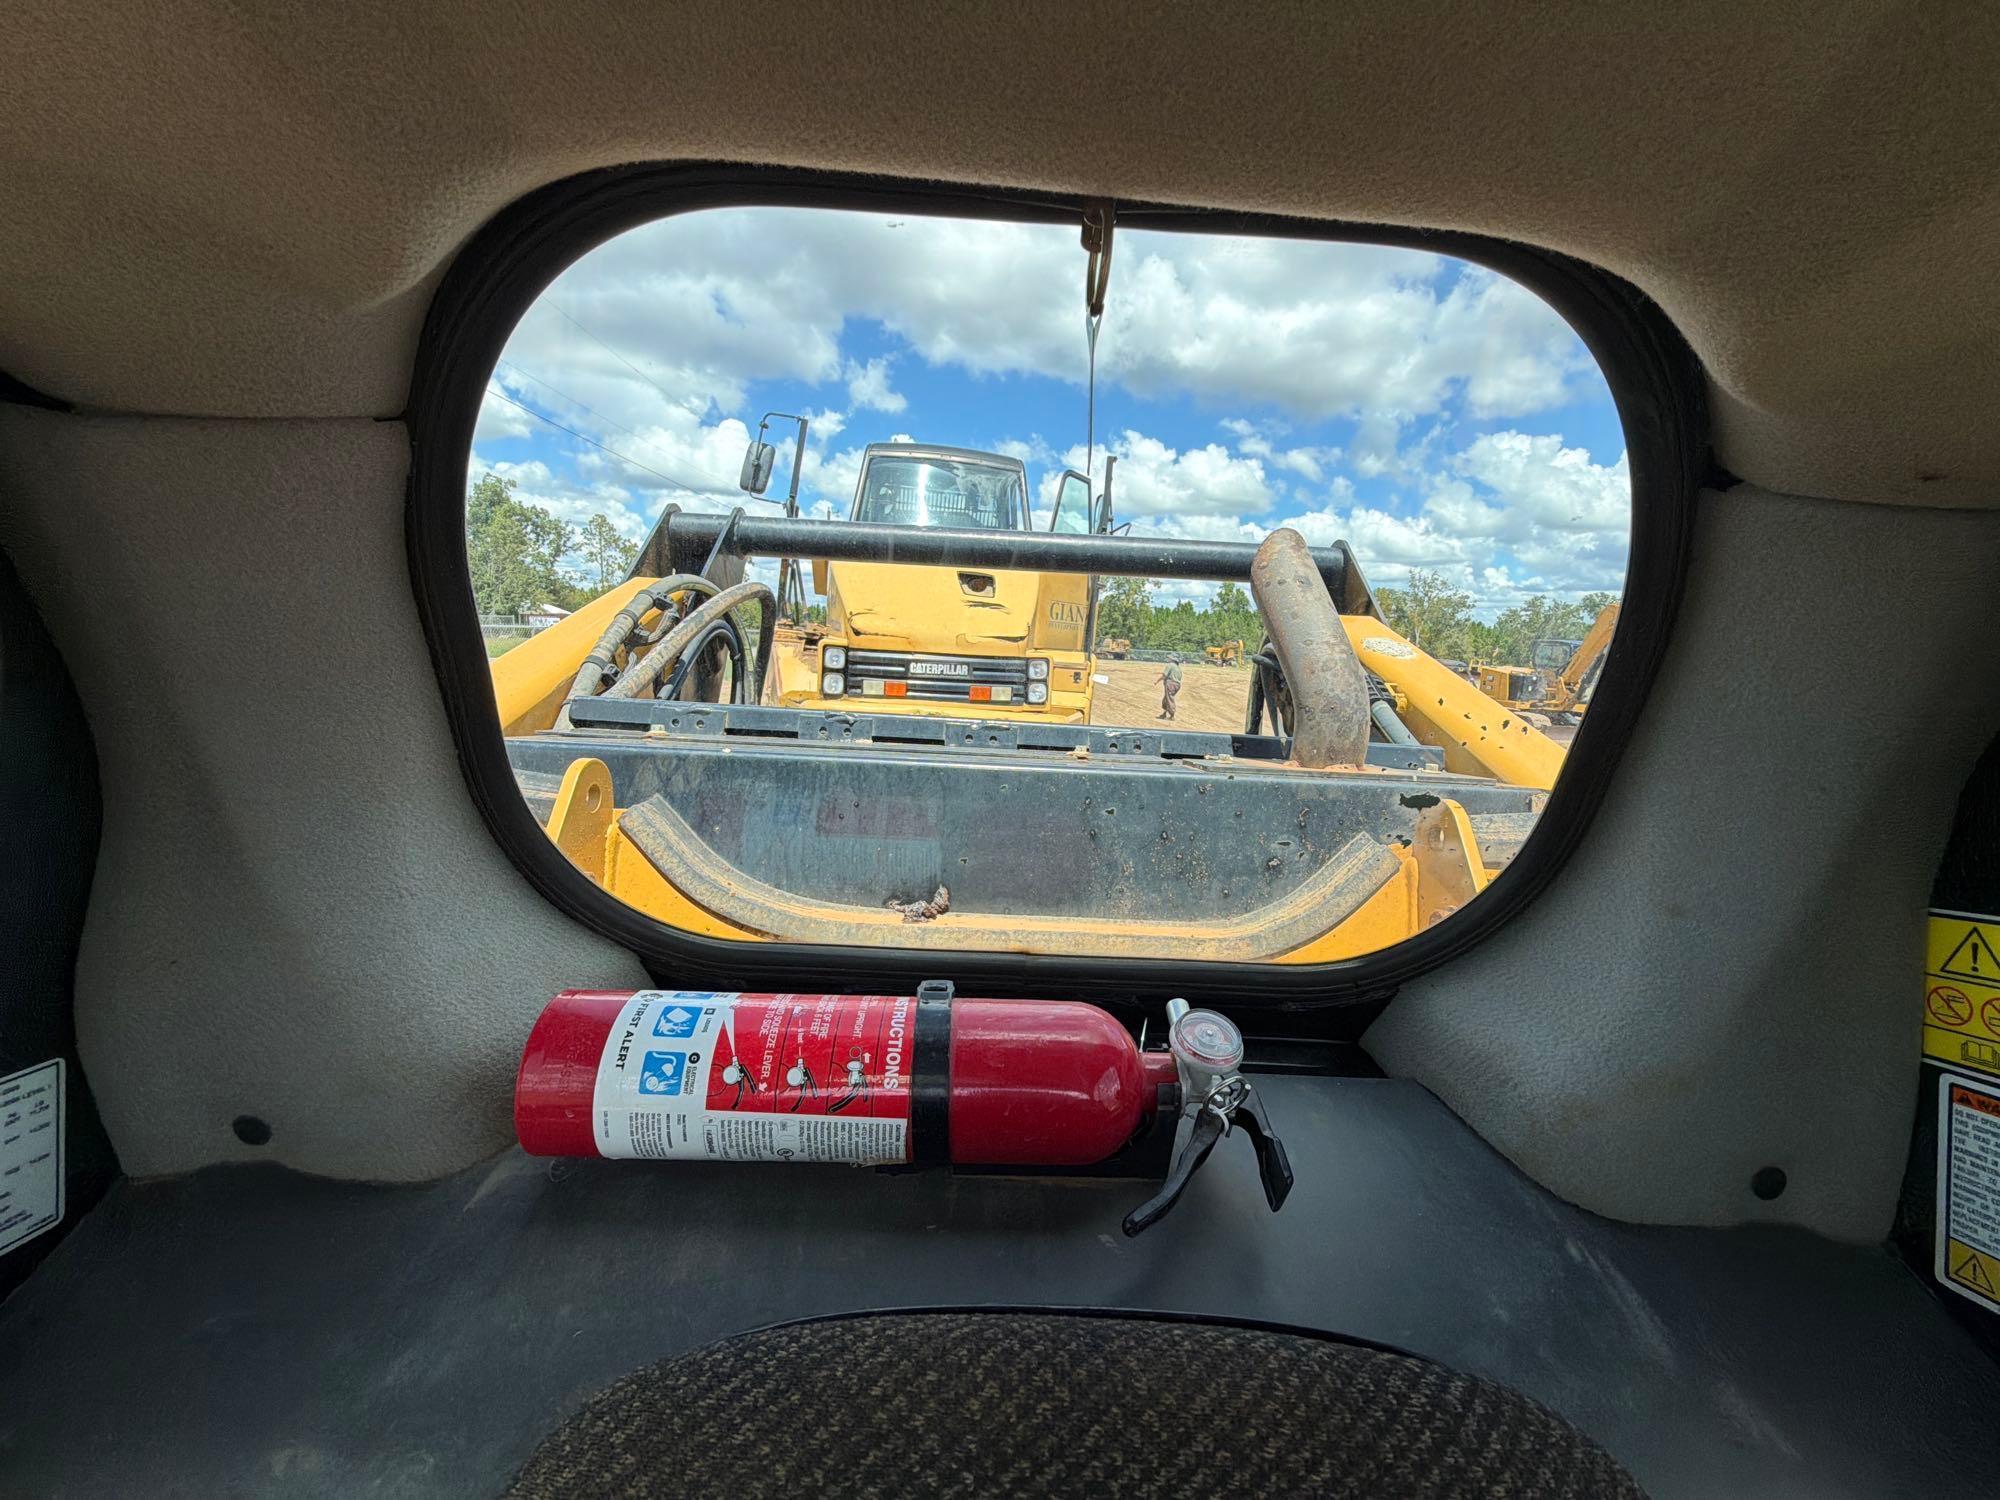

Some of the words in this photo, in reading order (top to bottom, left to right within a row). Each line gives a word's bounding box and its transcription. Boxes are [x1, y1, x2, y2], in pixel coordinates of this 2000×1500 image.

[909, 662, 969, 676] CATERPILLAR
[629, 1002, 650, 1028] FIRST
[852, 1010, 866, 1040] UPRIGHT.
[765, 1015, 783, 1048] SQUEEZE
[615, 1030, 635, 1070] ALERT
[760, 1050, 774, 1080] LEVER.
[683, 1066, 692, 1094] EQUIPMENT
[688, 1066, 697, 1096] ELECTRICAL
